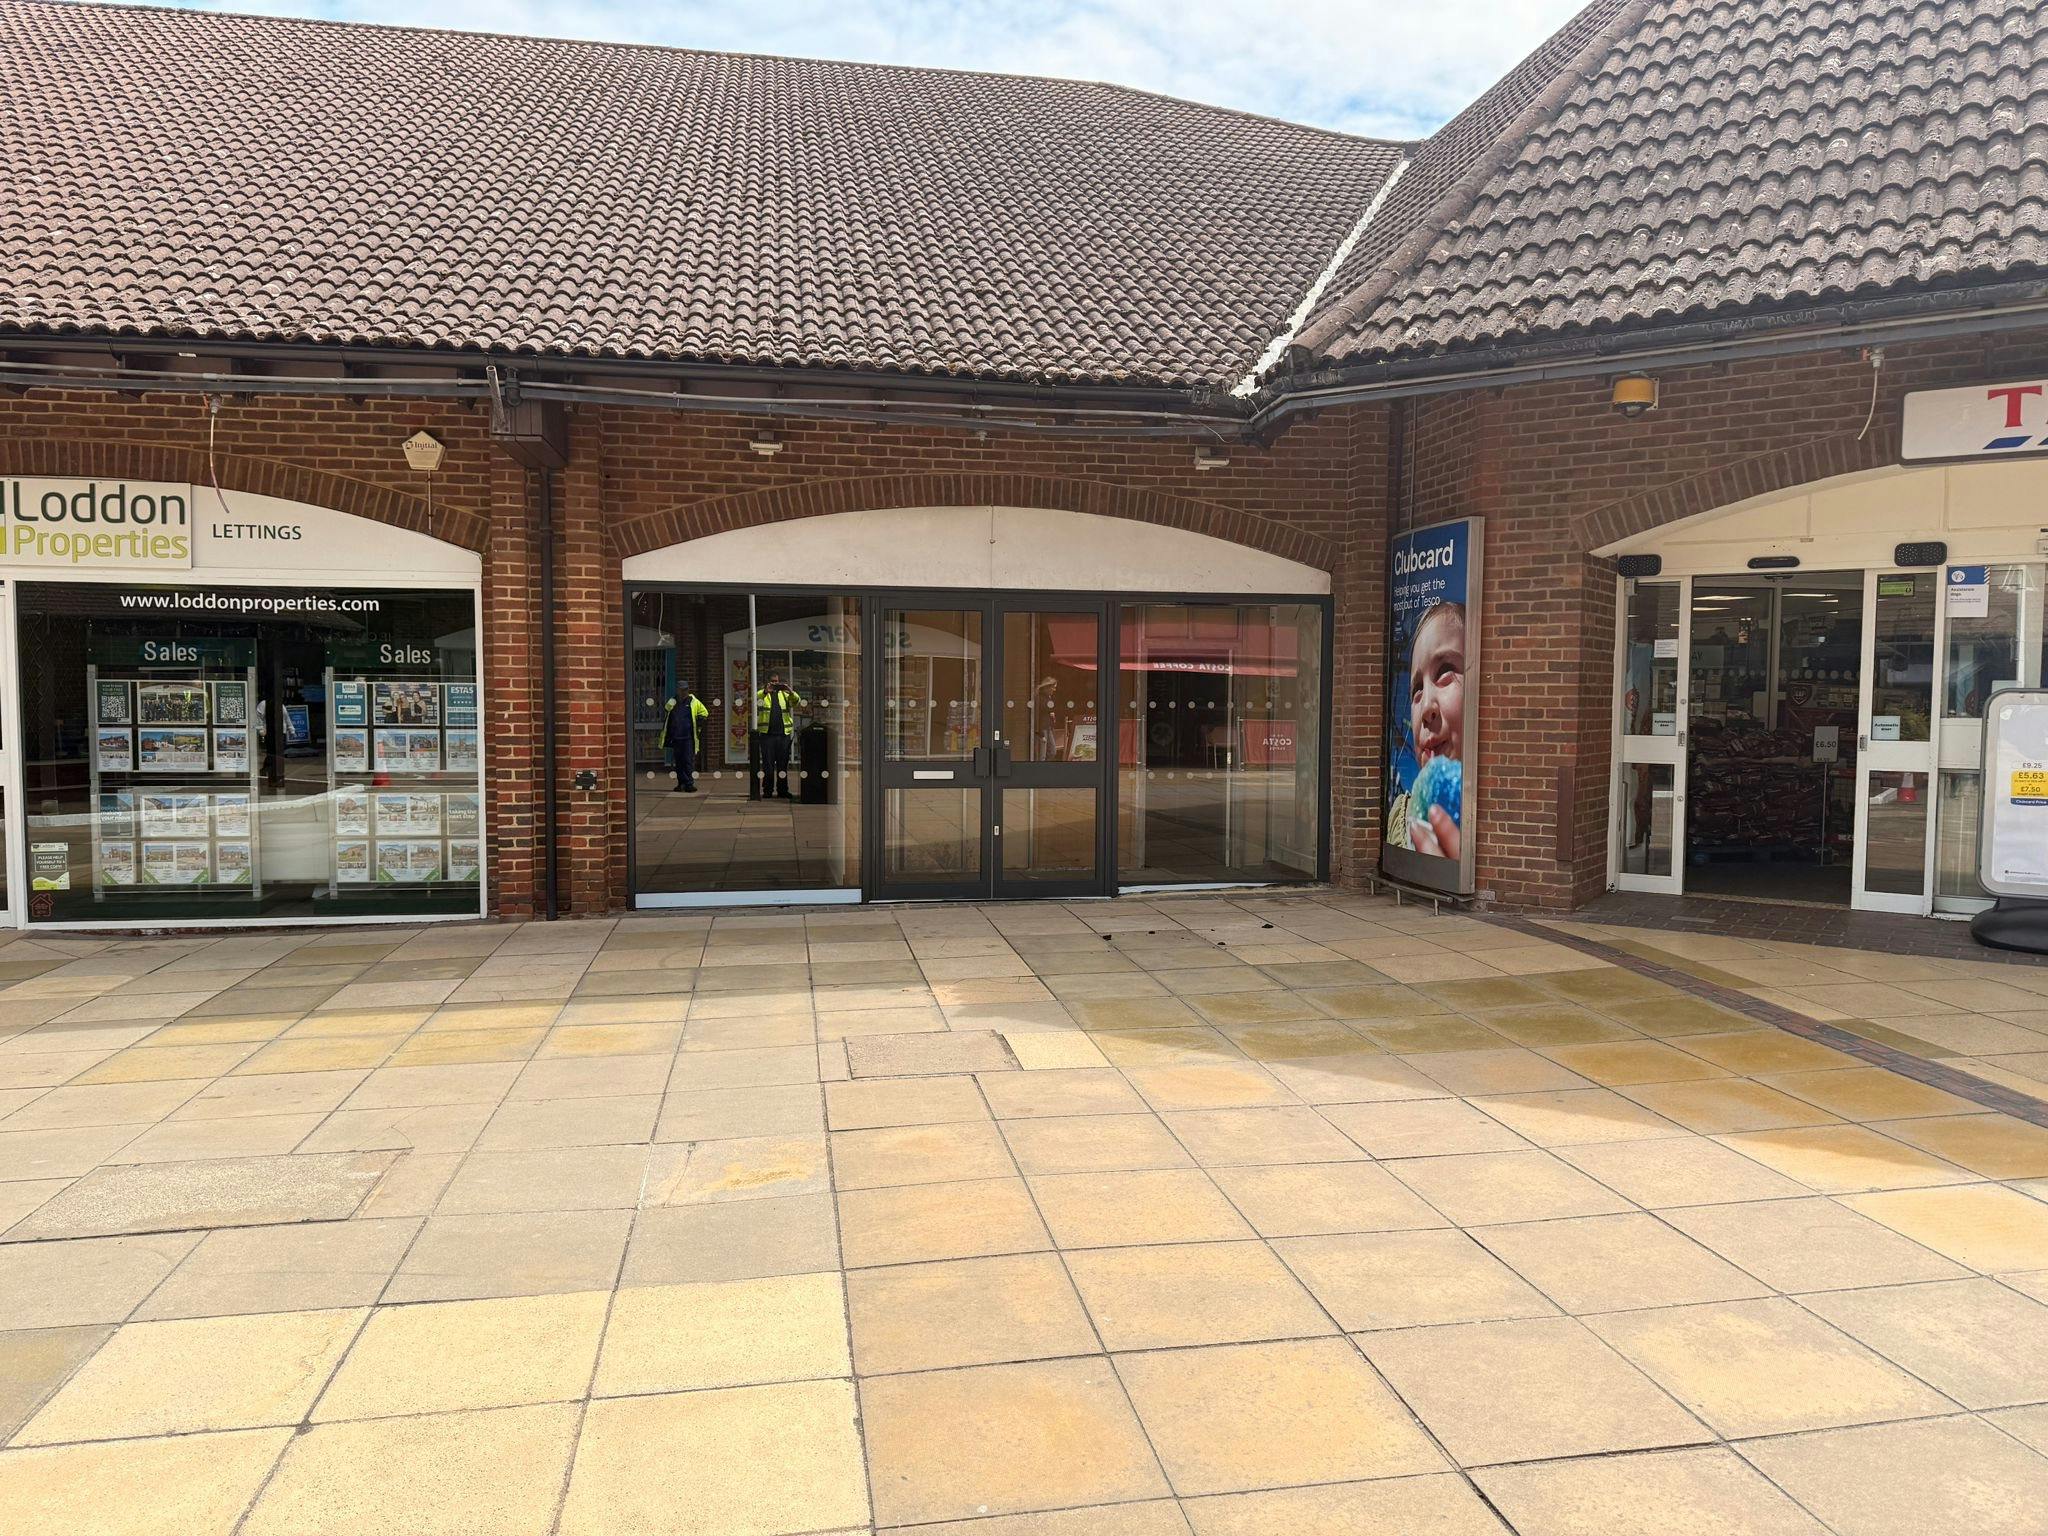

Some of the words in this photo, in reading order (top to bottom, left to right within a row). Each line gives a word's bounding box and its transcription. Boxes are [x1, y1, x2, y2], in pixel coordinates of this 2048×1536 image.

[1988, 385, 2048, 428] T
[415, 441, 438, 449] Initial
[13, 481, 186, 525] Loddon
[213, 523, 302, 540] LETTINGS
[13, 525, 188, 563] Properties
[1394, 539, 1454, 575] Clubcard
[1393, 585, 1409, 598] Helping
[1409, 584, 1420, 596] you
[1420, 580, 1432, 595] get
[1432, 578, 1446, 590] the
[120, 592, 380, 614] www.loddonproperties.com
[1403, 598, 1413, 610] out
[1413, 596, 1420, 608] of
[1420, 595, 1441, 607] Tesco
[144, 641, 198, 662] Sales
[380, 644, 431, 664] Sales
[450, 686, 474, 694] ESTAS
[2018, 772, 2045, 780] £5.63
